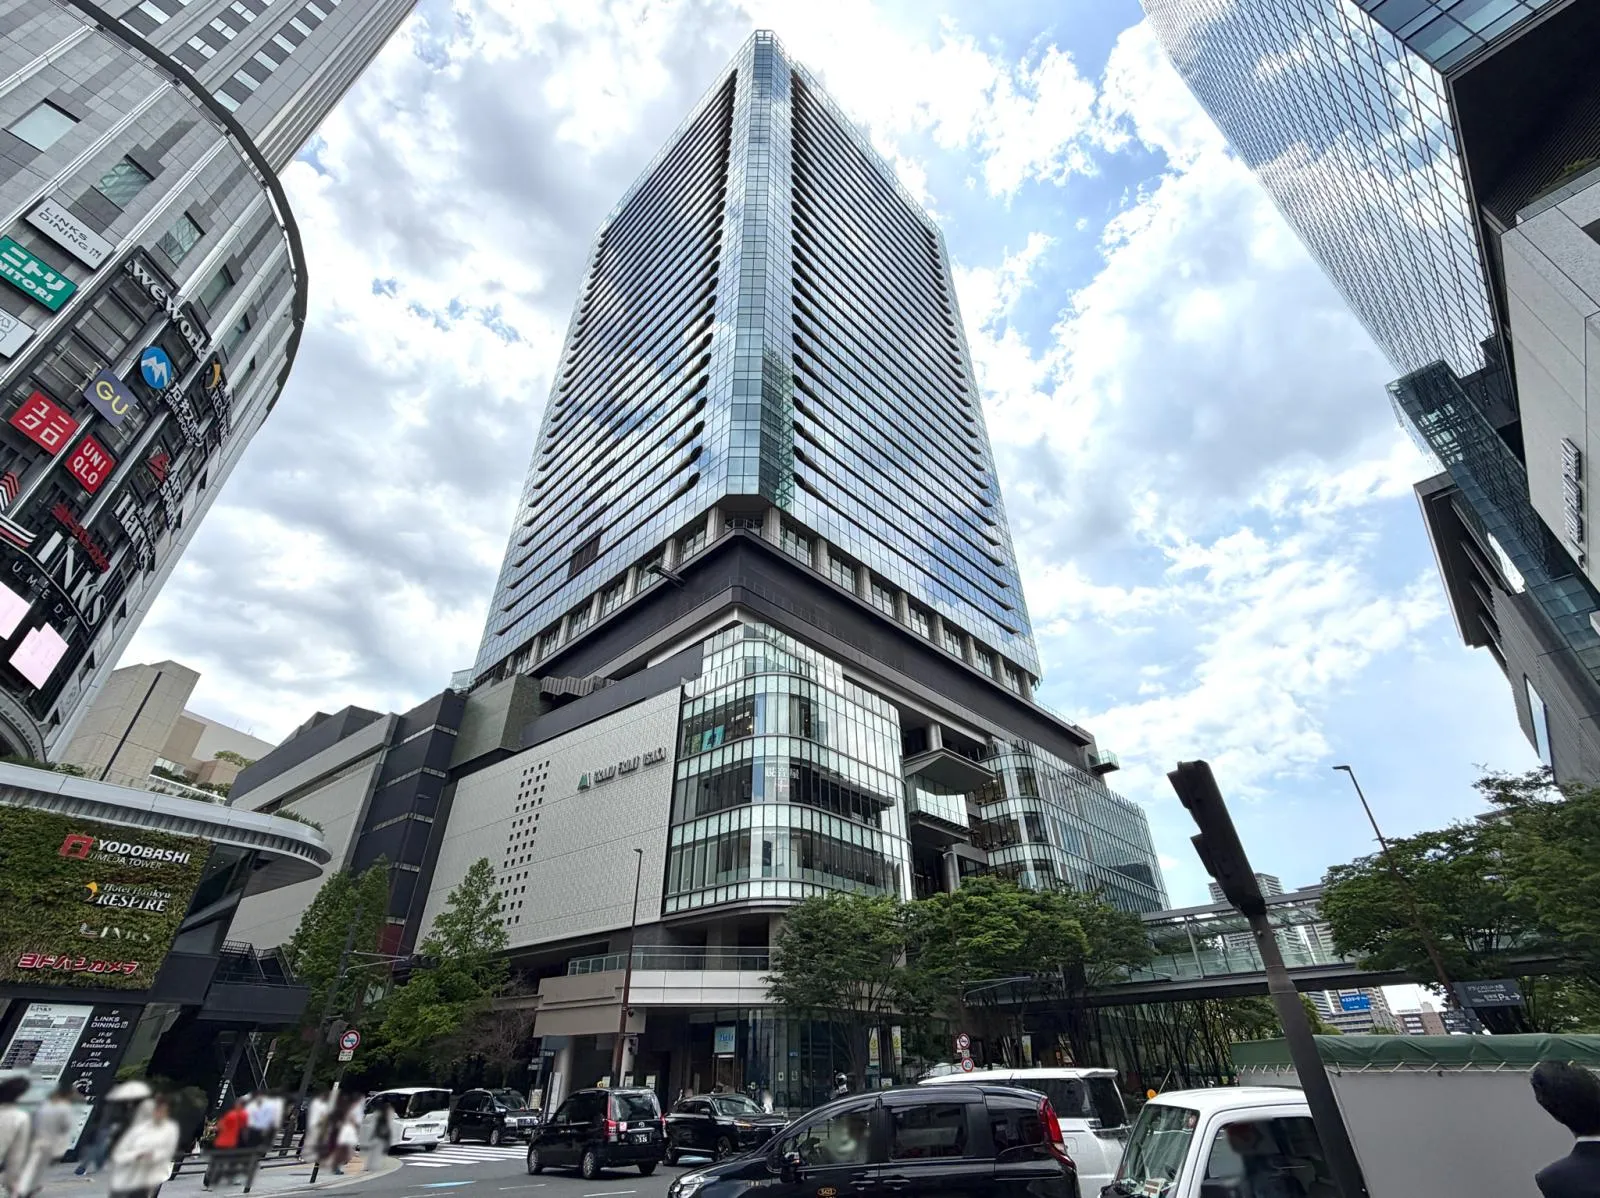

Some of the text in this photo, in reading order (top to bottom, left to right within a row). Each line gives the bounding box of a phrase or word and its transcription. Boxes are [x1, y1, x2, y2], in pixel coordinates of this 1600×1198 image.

[38, 212, 88, 250] DINING
[45, 207, 88, 241] LINKS
[1, 246, 67, 291] ニトリ
[96, 380, 129, 415] GU
[73, 456, 98, 485] QLO
[83, 442, 107, 472] UNI
[99, 839, 191, 864] YODOBASHI
[128, 858, 162, 869] TOWER
[96, 893, 168, 912] RESPIRE
